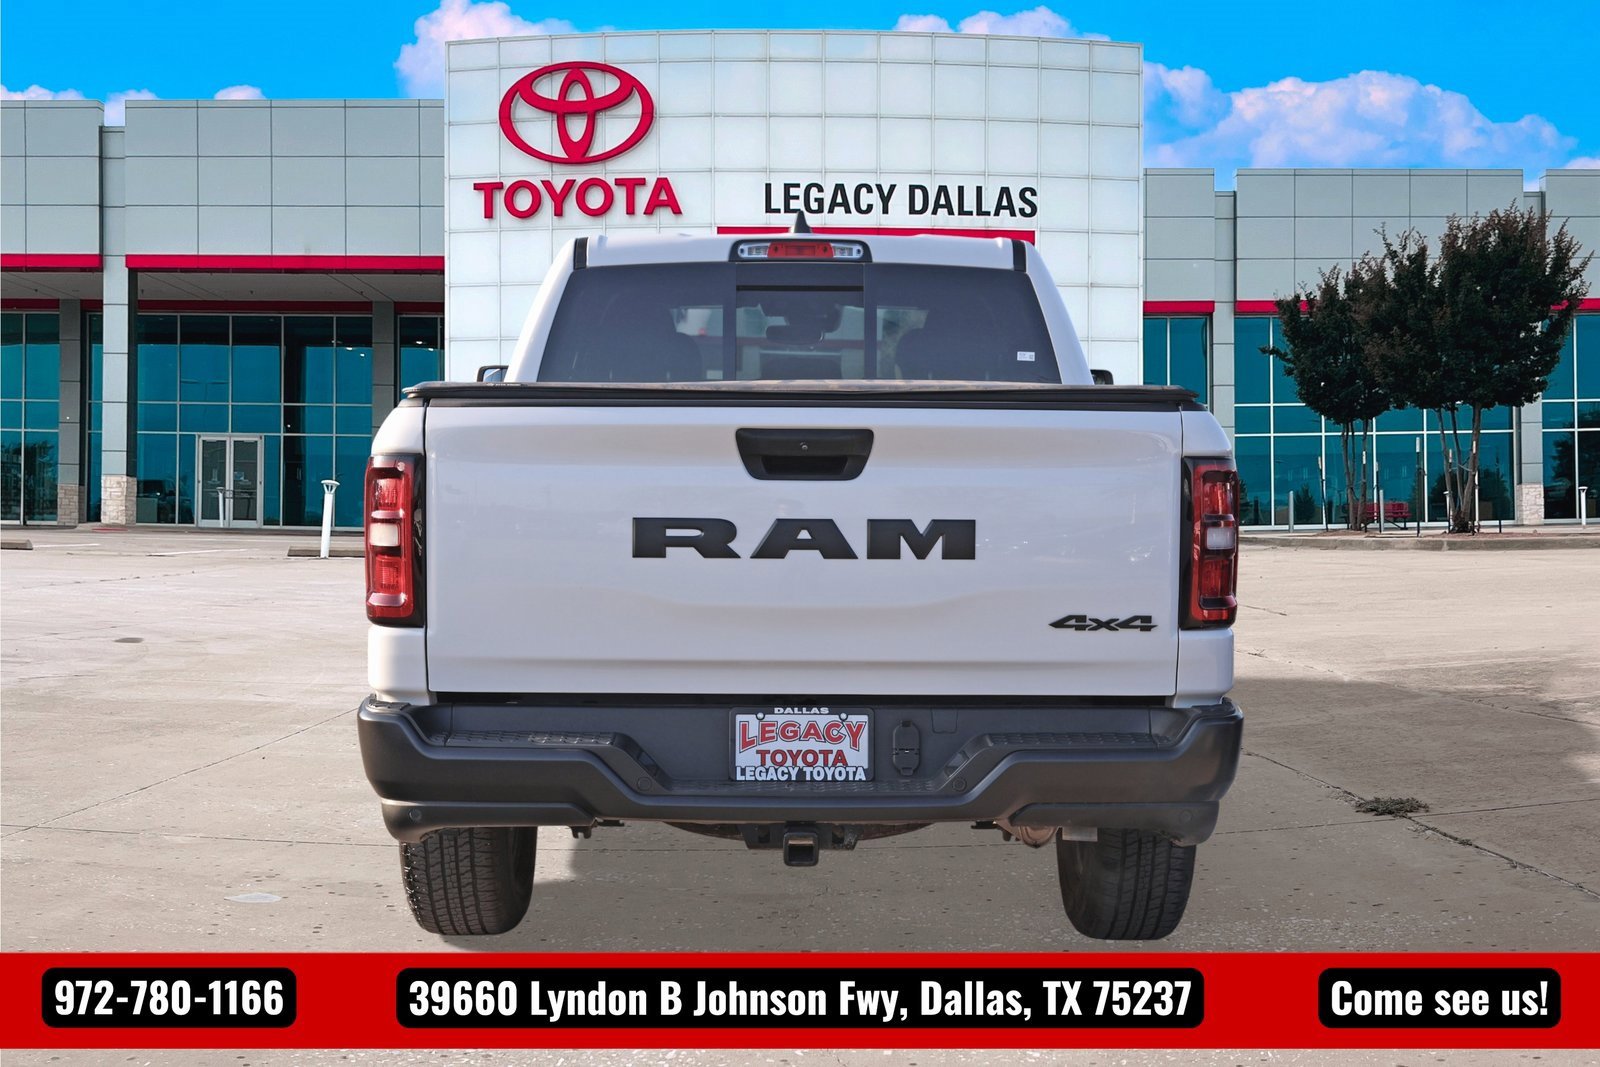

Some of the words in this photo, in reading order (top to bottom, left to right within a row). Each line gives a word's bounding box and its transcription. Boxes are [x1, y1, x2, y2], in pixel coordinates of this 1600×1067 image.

[473, 177, 682, 219] TOYOTA
[765, 182, 897, 215] LEGACY
[908, 185, 1038, 218] DALLAS
[632, 517, 976, 560] RAM
[1048, 614, 1158, 632] 4x4
[739, 720, 867, 753] LEGACY
[736, 766, 799, 781] LEGACY
[803, 766, 867, 781] TOYOTA
[756, 749, 848, 767] TOYOTA
